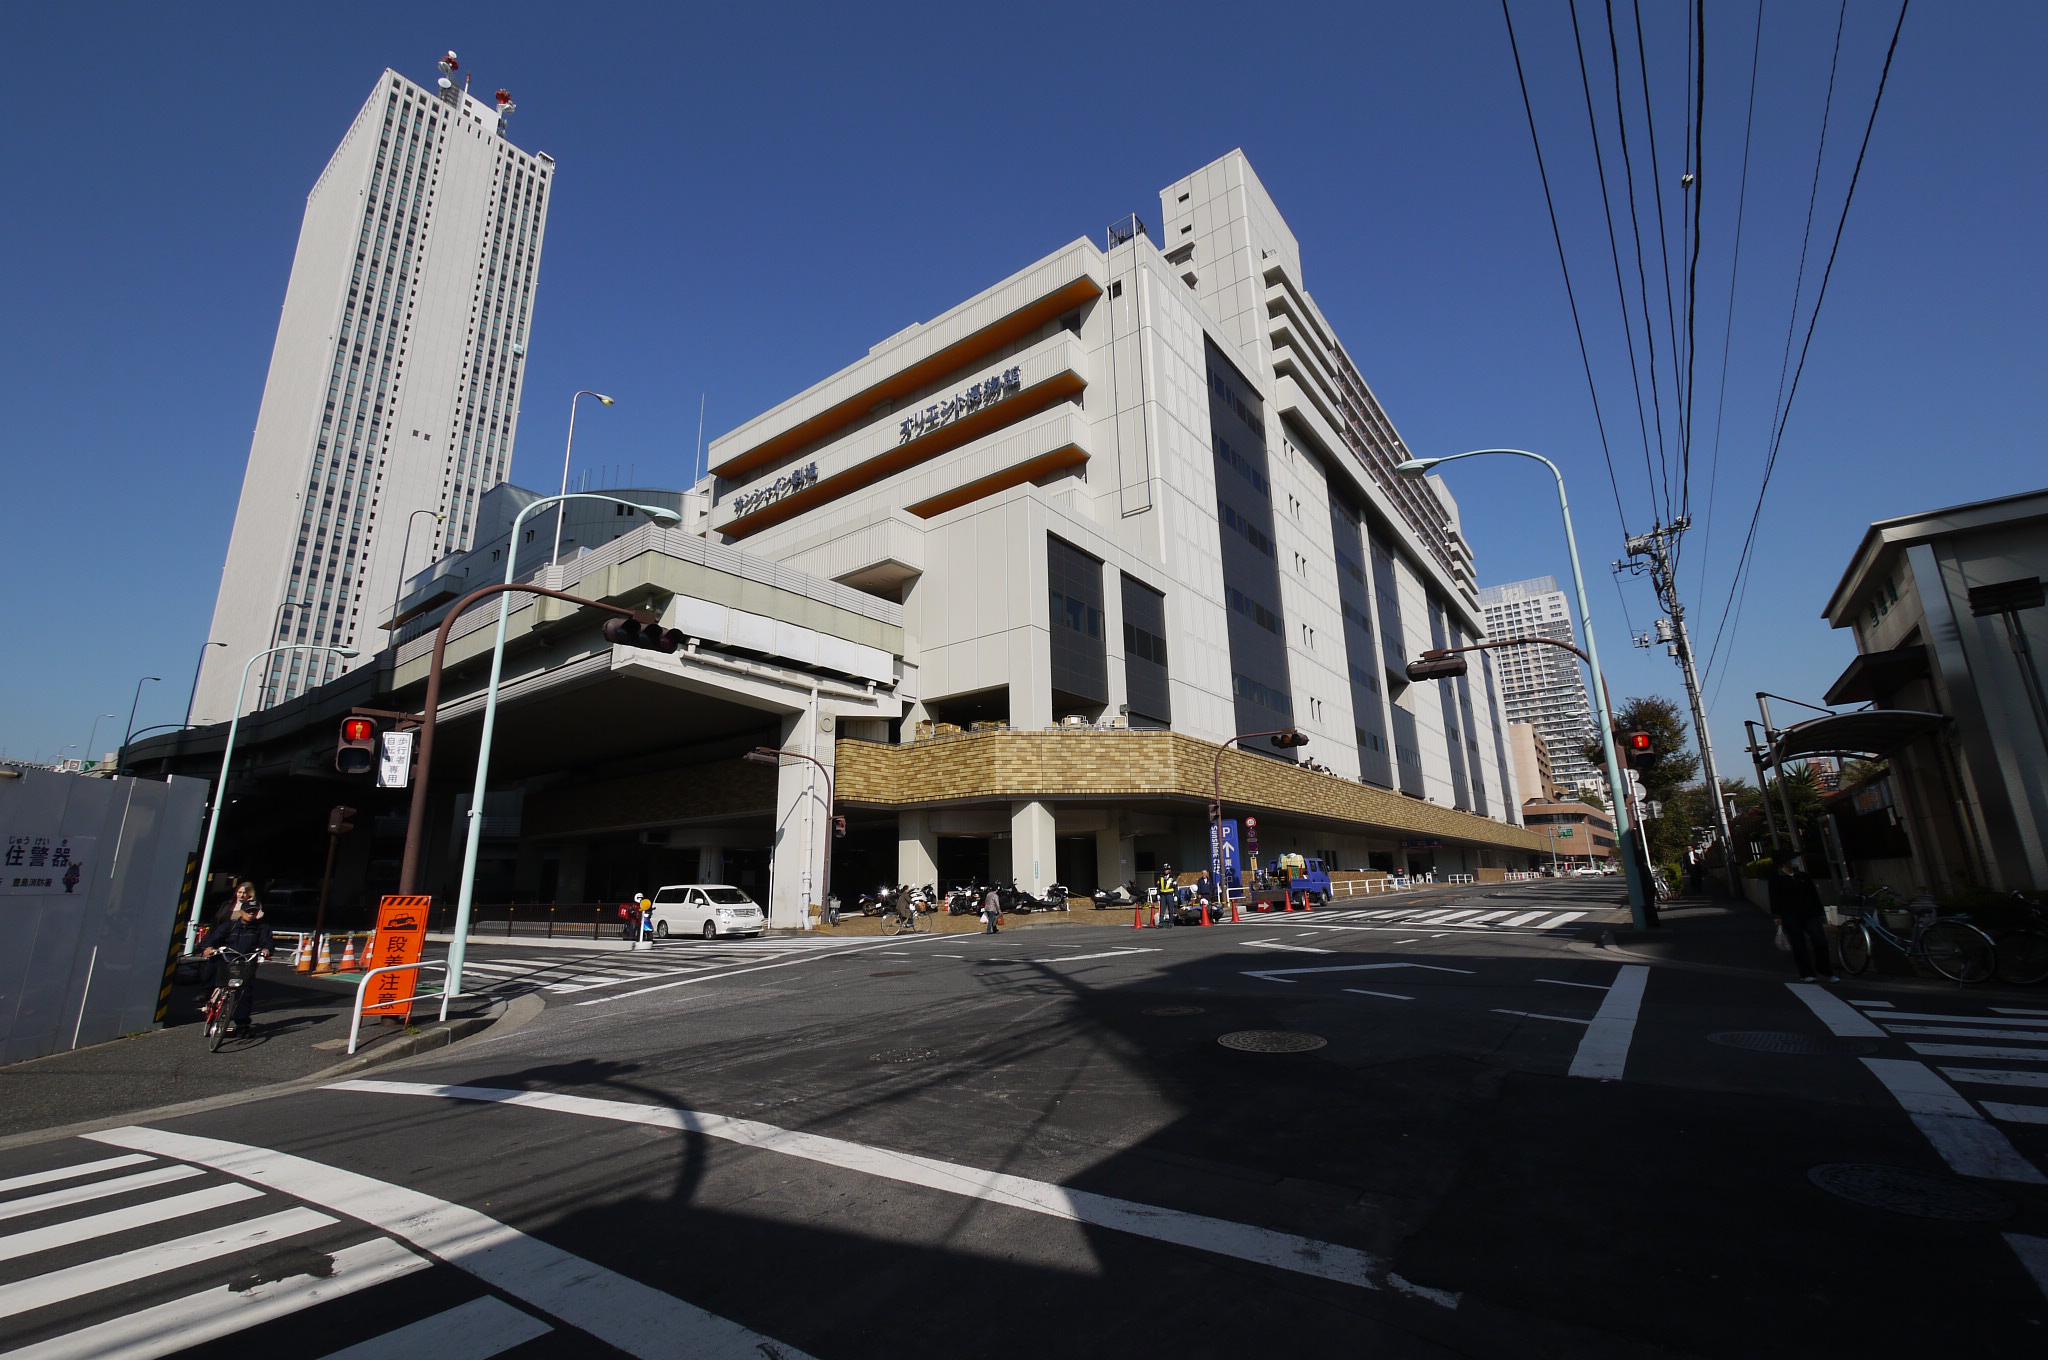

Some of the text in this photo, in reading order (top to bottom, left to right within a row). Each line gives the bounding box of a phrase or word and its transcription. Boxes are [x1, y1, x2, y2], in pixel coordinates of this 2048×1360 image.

[899, 366, 1021, 436] オリエント博物館
[733, 461, 819, 512] サンシャイン劇場
[1222, 826, 1231, 838] P
[5, 845, 71, 867] 住警器
